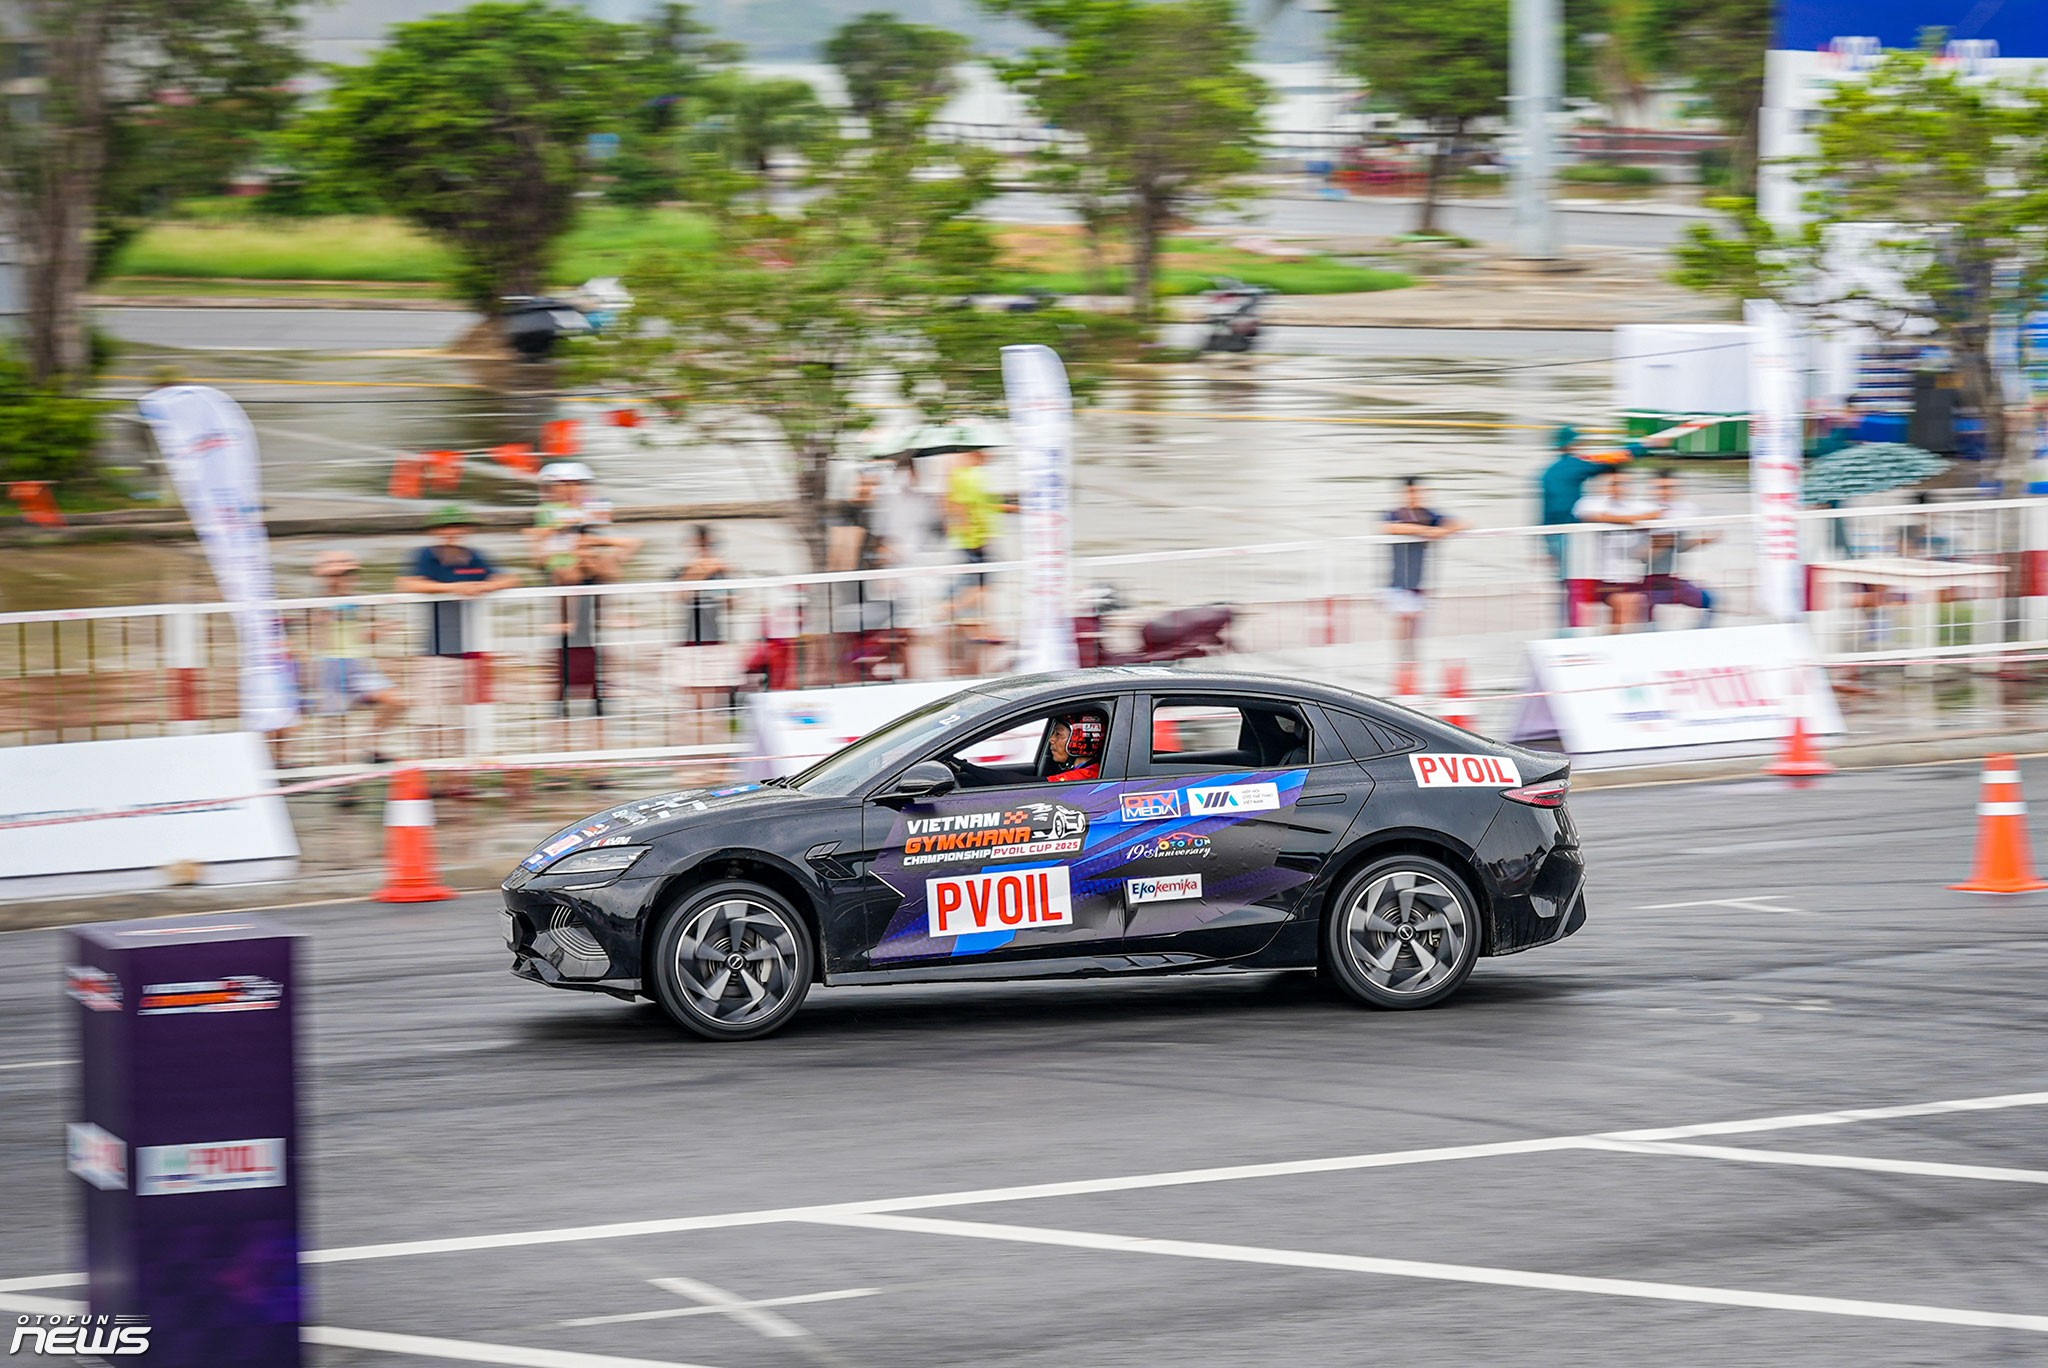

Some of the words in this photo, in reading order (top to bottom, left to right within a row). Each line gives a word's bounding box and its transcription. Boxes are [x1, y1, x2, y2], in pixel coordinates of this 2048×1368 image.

[1416, 756, 1515, 784] PVOIL
[1125, 804, 1178, 819] MEDIA
[906, 812, 1000, 834] VIETNAM
[904, 826, 1032, 855] GYMKHANA
[994, 847, 1026, 857] PVOIL
[1029, 843, 1052, 853] CUP
[1055, 841, 1079, 851] 2025
[903, 849, 991, 866] CHAMPIONSHIP
[1143, 846, 1211, 859] Anniversary
[1132, 878, 1198, 899] Ekokemika
[936, 872, 1064, 932] PVOIL
